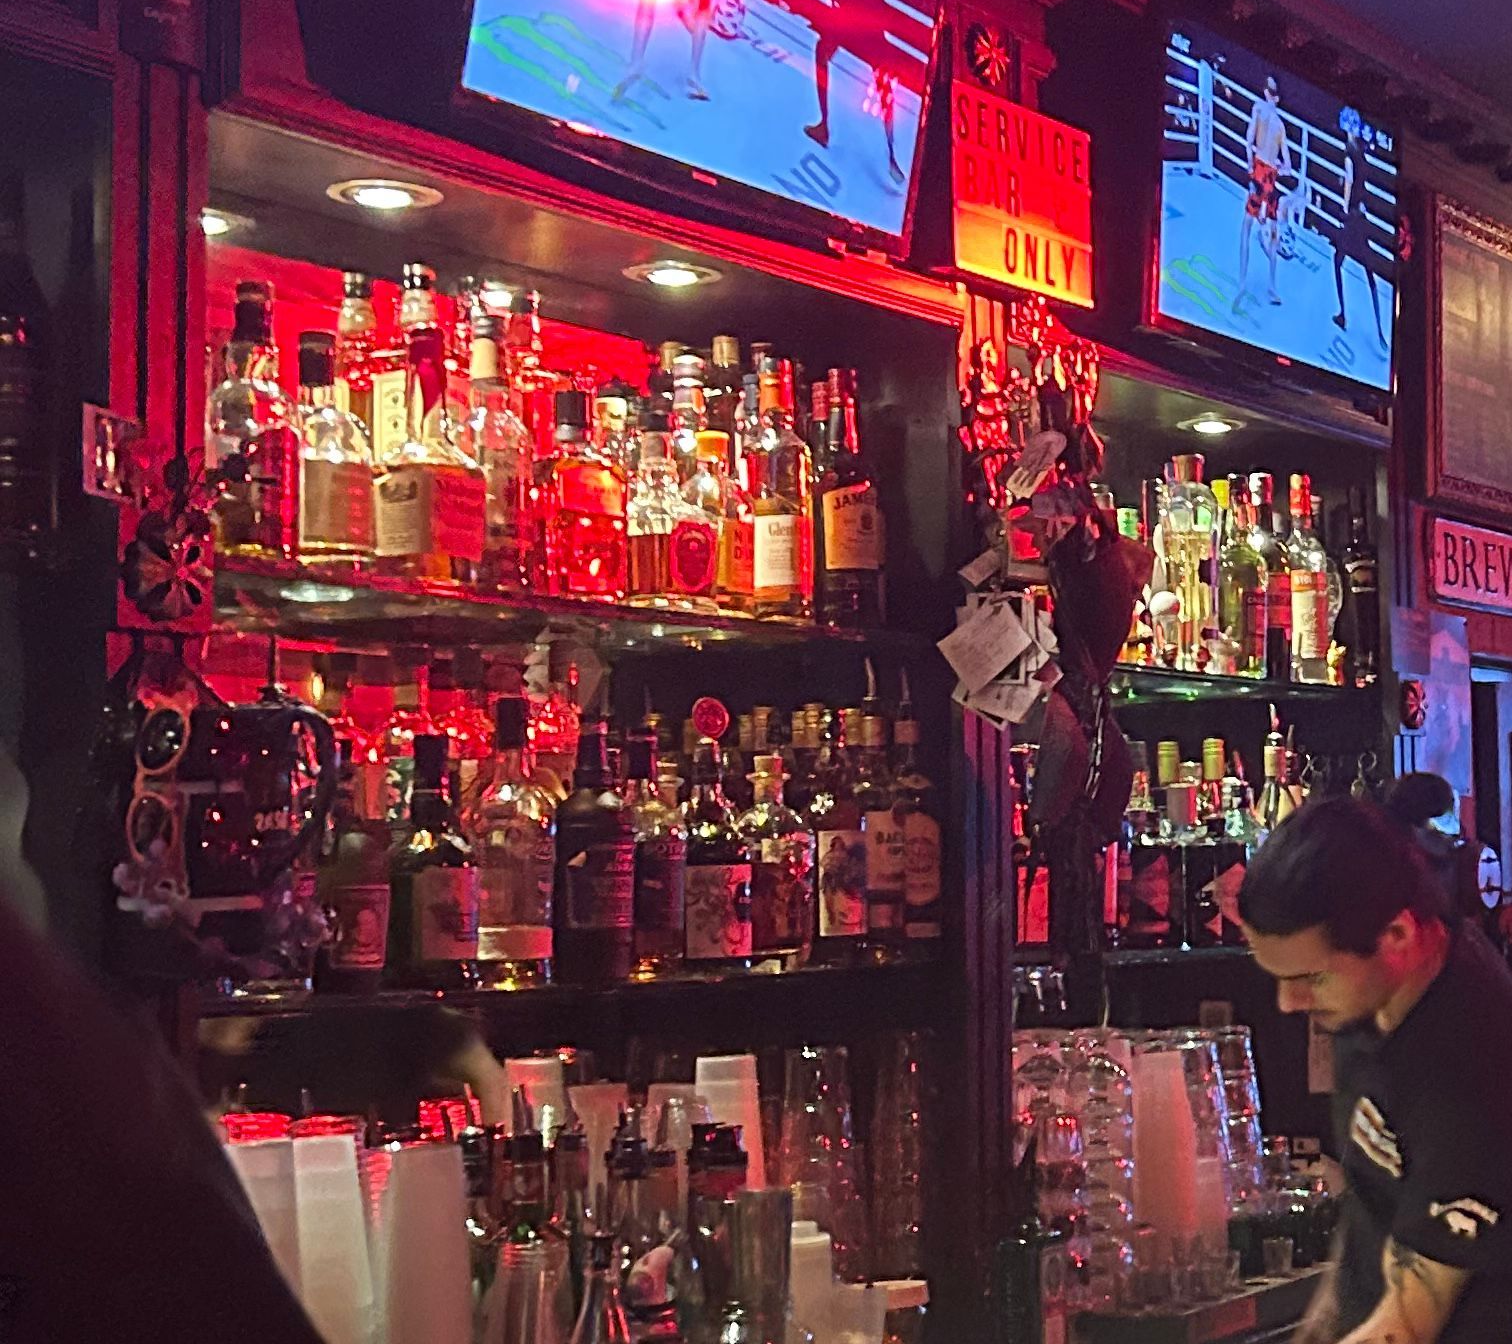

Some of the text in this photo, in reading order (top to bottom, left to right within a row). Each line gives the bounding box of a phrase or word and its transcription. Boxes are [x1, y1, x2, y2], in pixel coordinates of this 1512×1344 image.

[957, 93, 1084, 184] SERVICE
[963, 155, 1021, 218] BAR
[1004, 227, 1075, 290] ONLY
